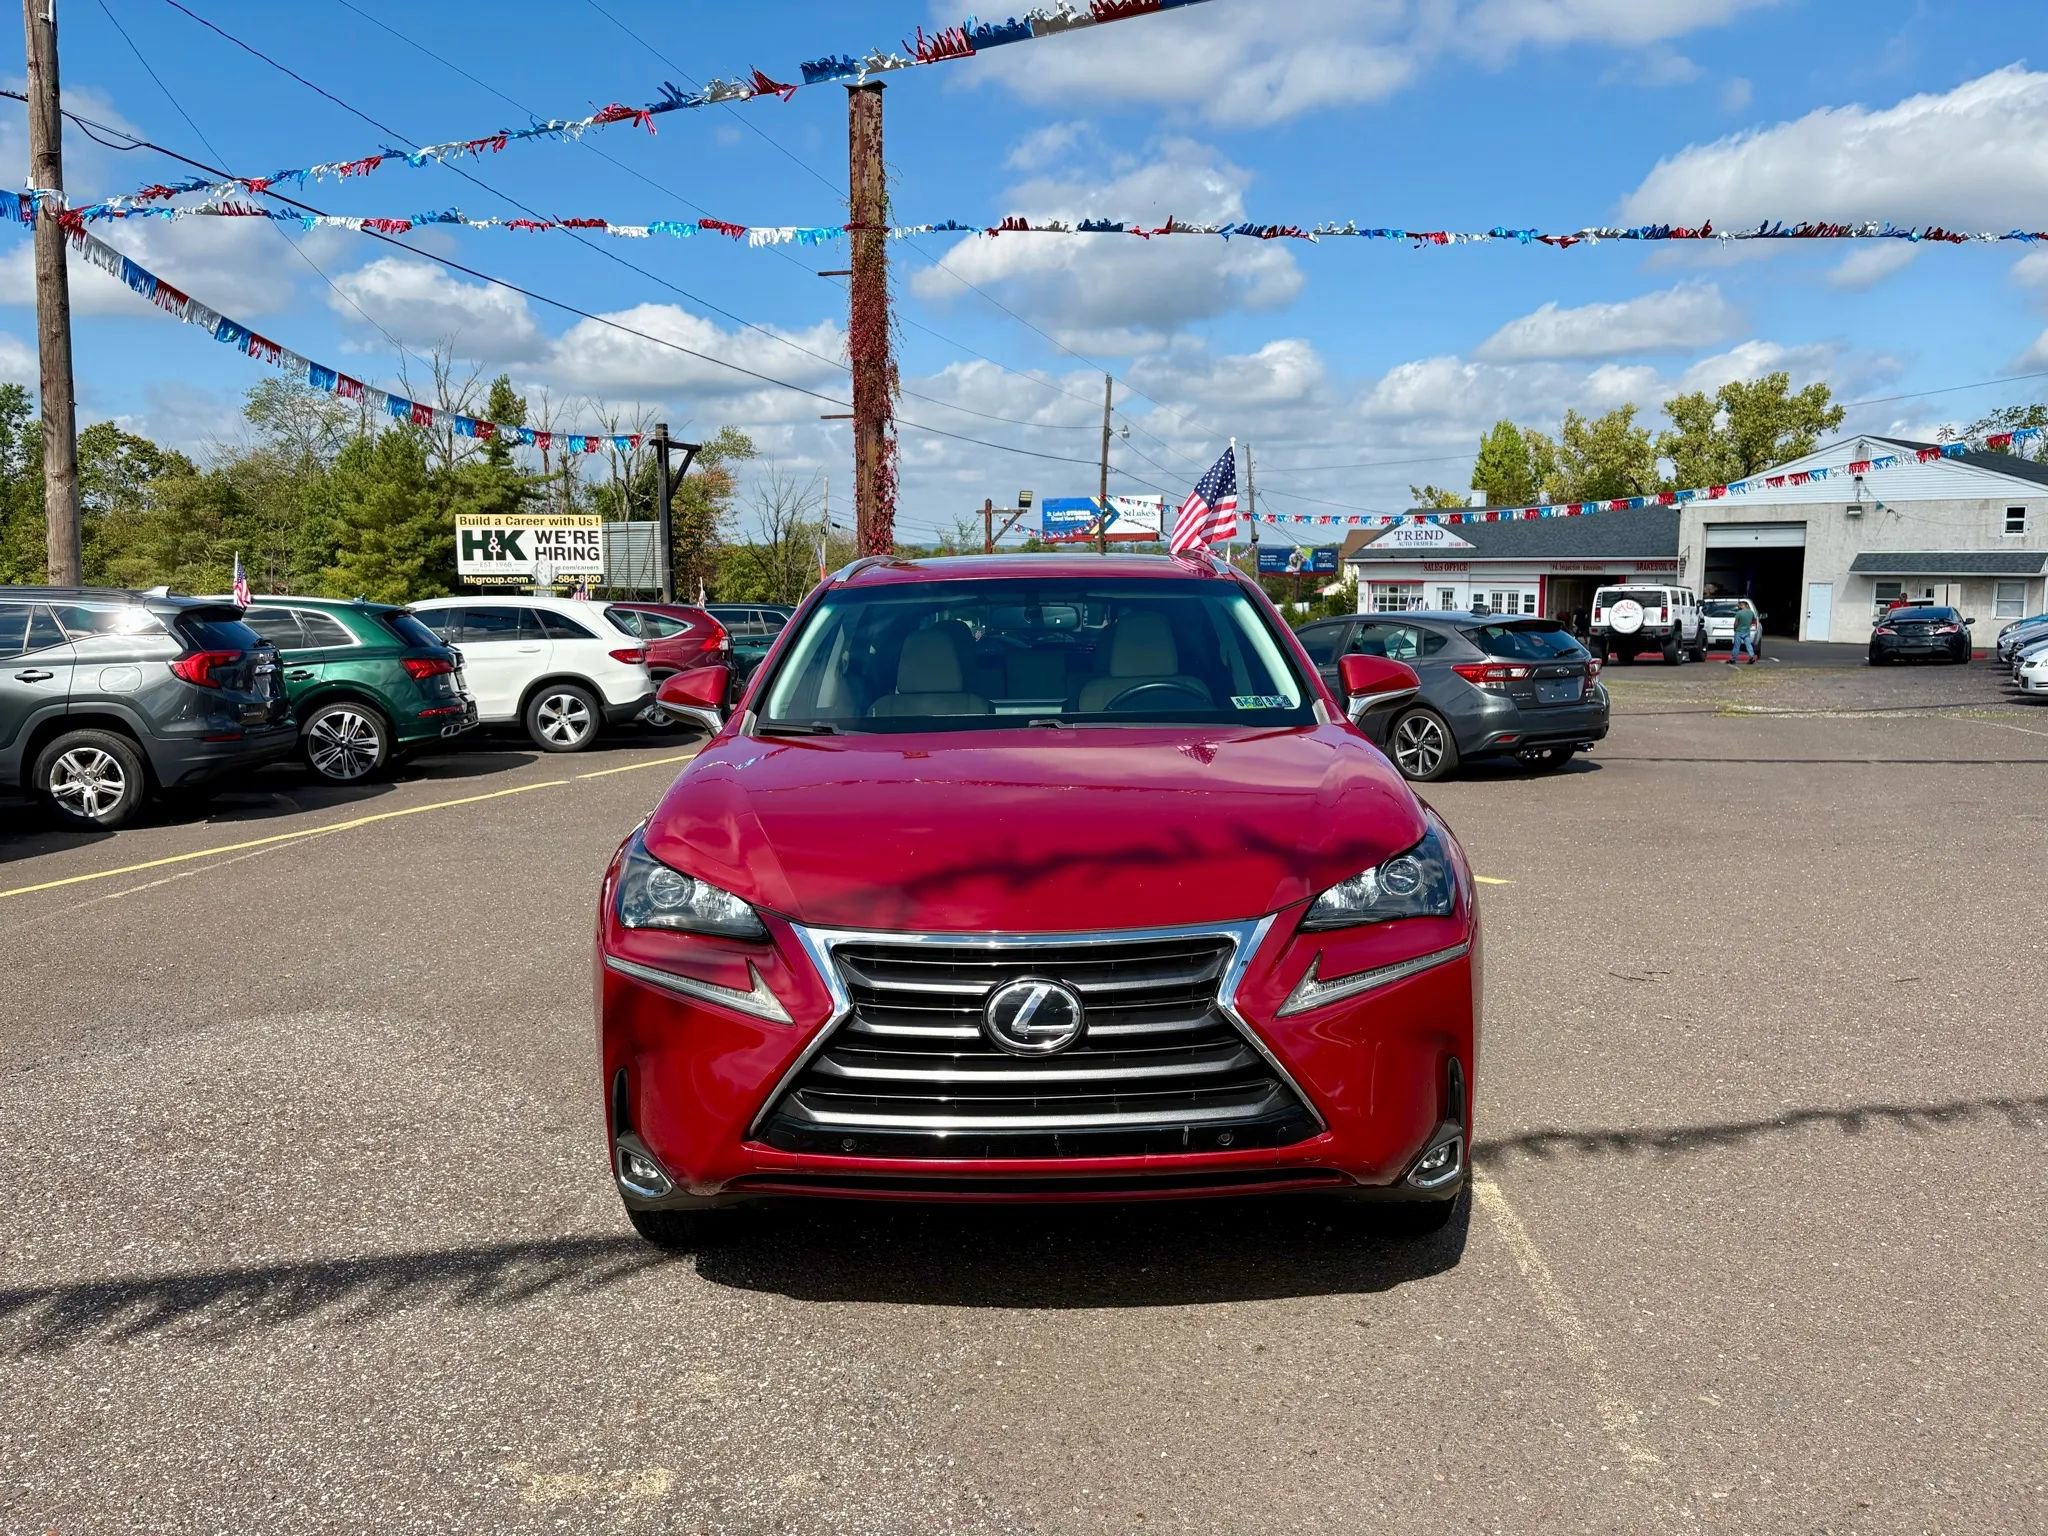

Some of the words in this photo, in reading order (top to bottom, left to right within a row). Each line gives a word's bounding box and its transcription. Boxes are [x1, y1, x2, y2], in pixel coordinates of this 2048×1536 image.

[459, 515, 491, 526] Build
[494, 517, 502, 526] a
[505, 515, 545, 526] Career
[549, 515, 575, 526] with
[534, 529, 600, 545] WE'RE
[1394, 530, 1444, 541] TREND
[461, 529, 527, 561] H&K
[535, 546, 601, 562] HIRING
[1423, 561, 1443, 572] SALES
[1444, 561, 1468, 572] OFFICE
[463, 575, 529, 586] hkgroup.com
